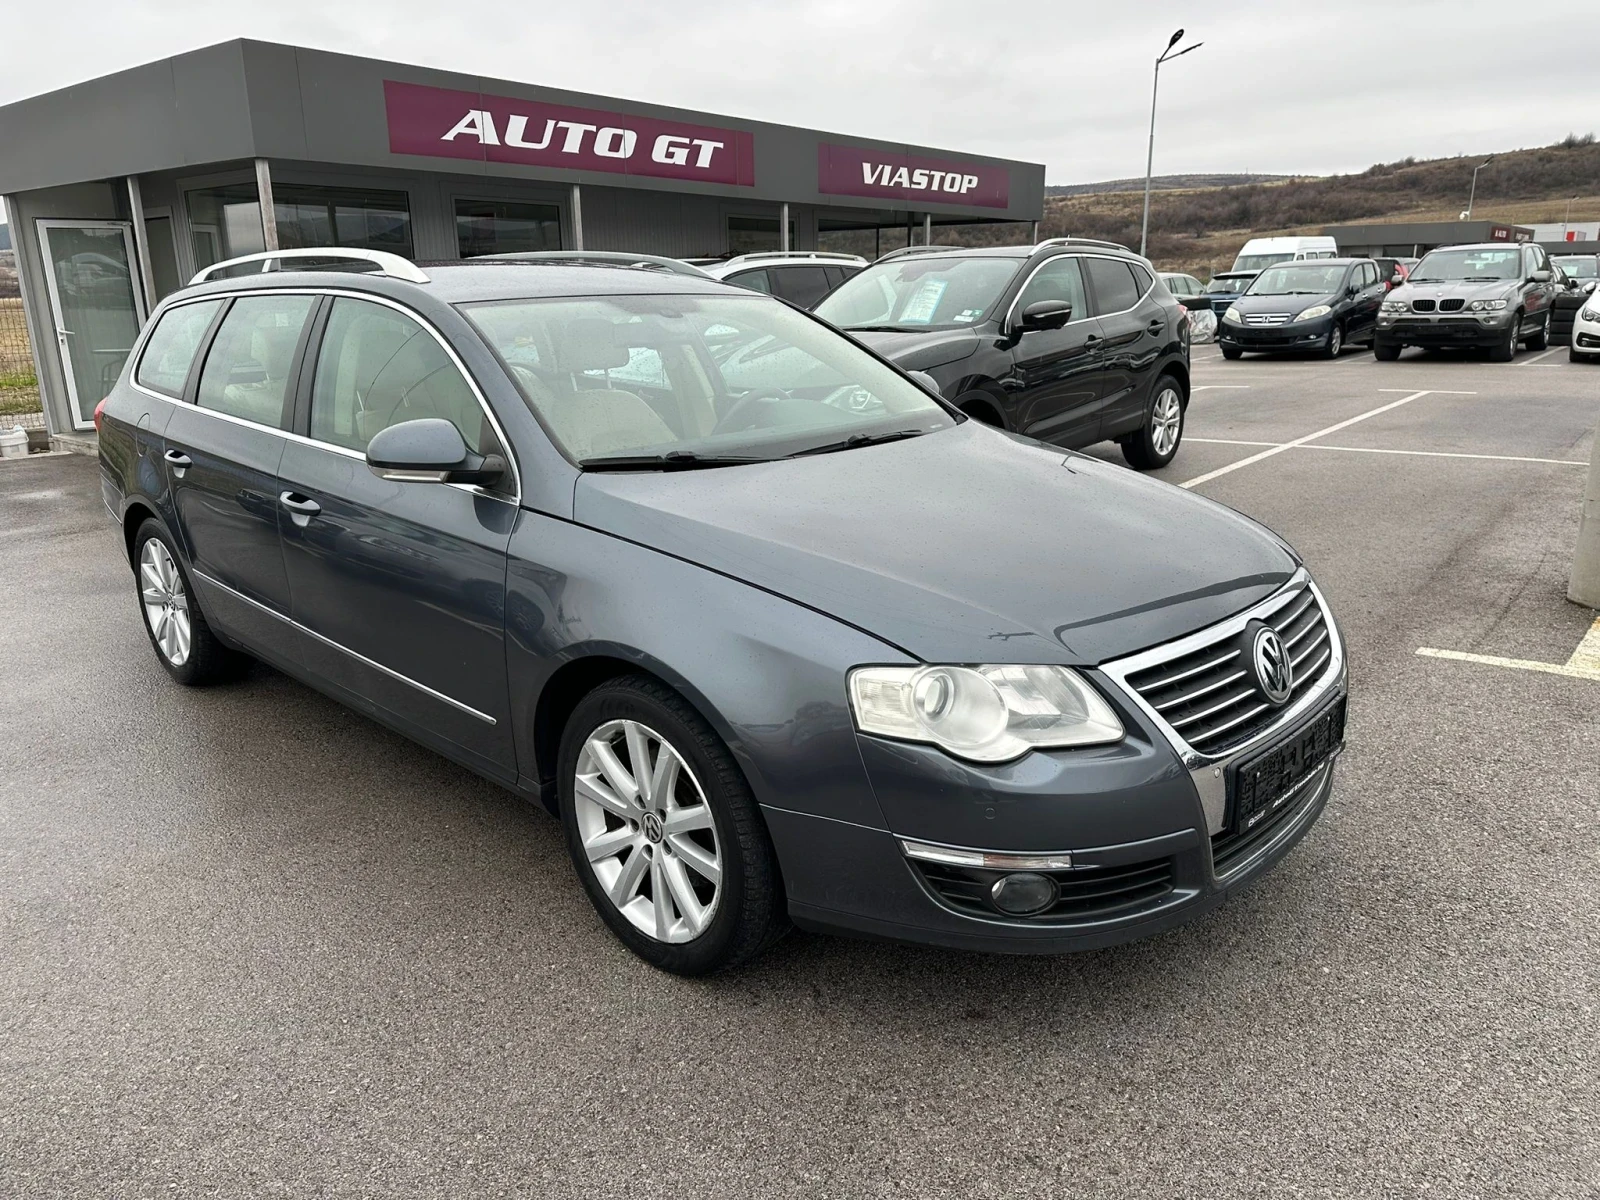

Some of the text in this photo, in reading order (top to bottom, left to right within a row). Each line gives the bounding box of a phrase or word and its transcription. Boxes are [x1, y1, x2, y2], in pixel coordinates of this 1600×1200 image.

[440, 109, 724, 169] AUTO GT
[862, 162, 978, 194] VIASTOP
